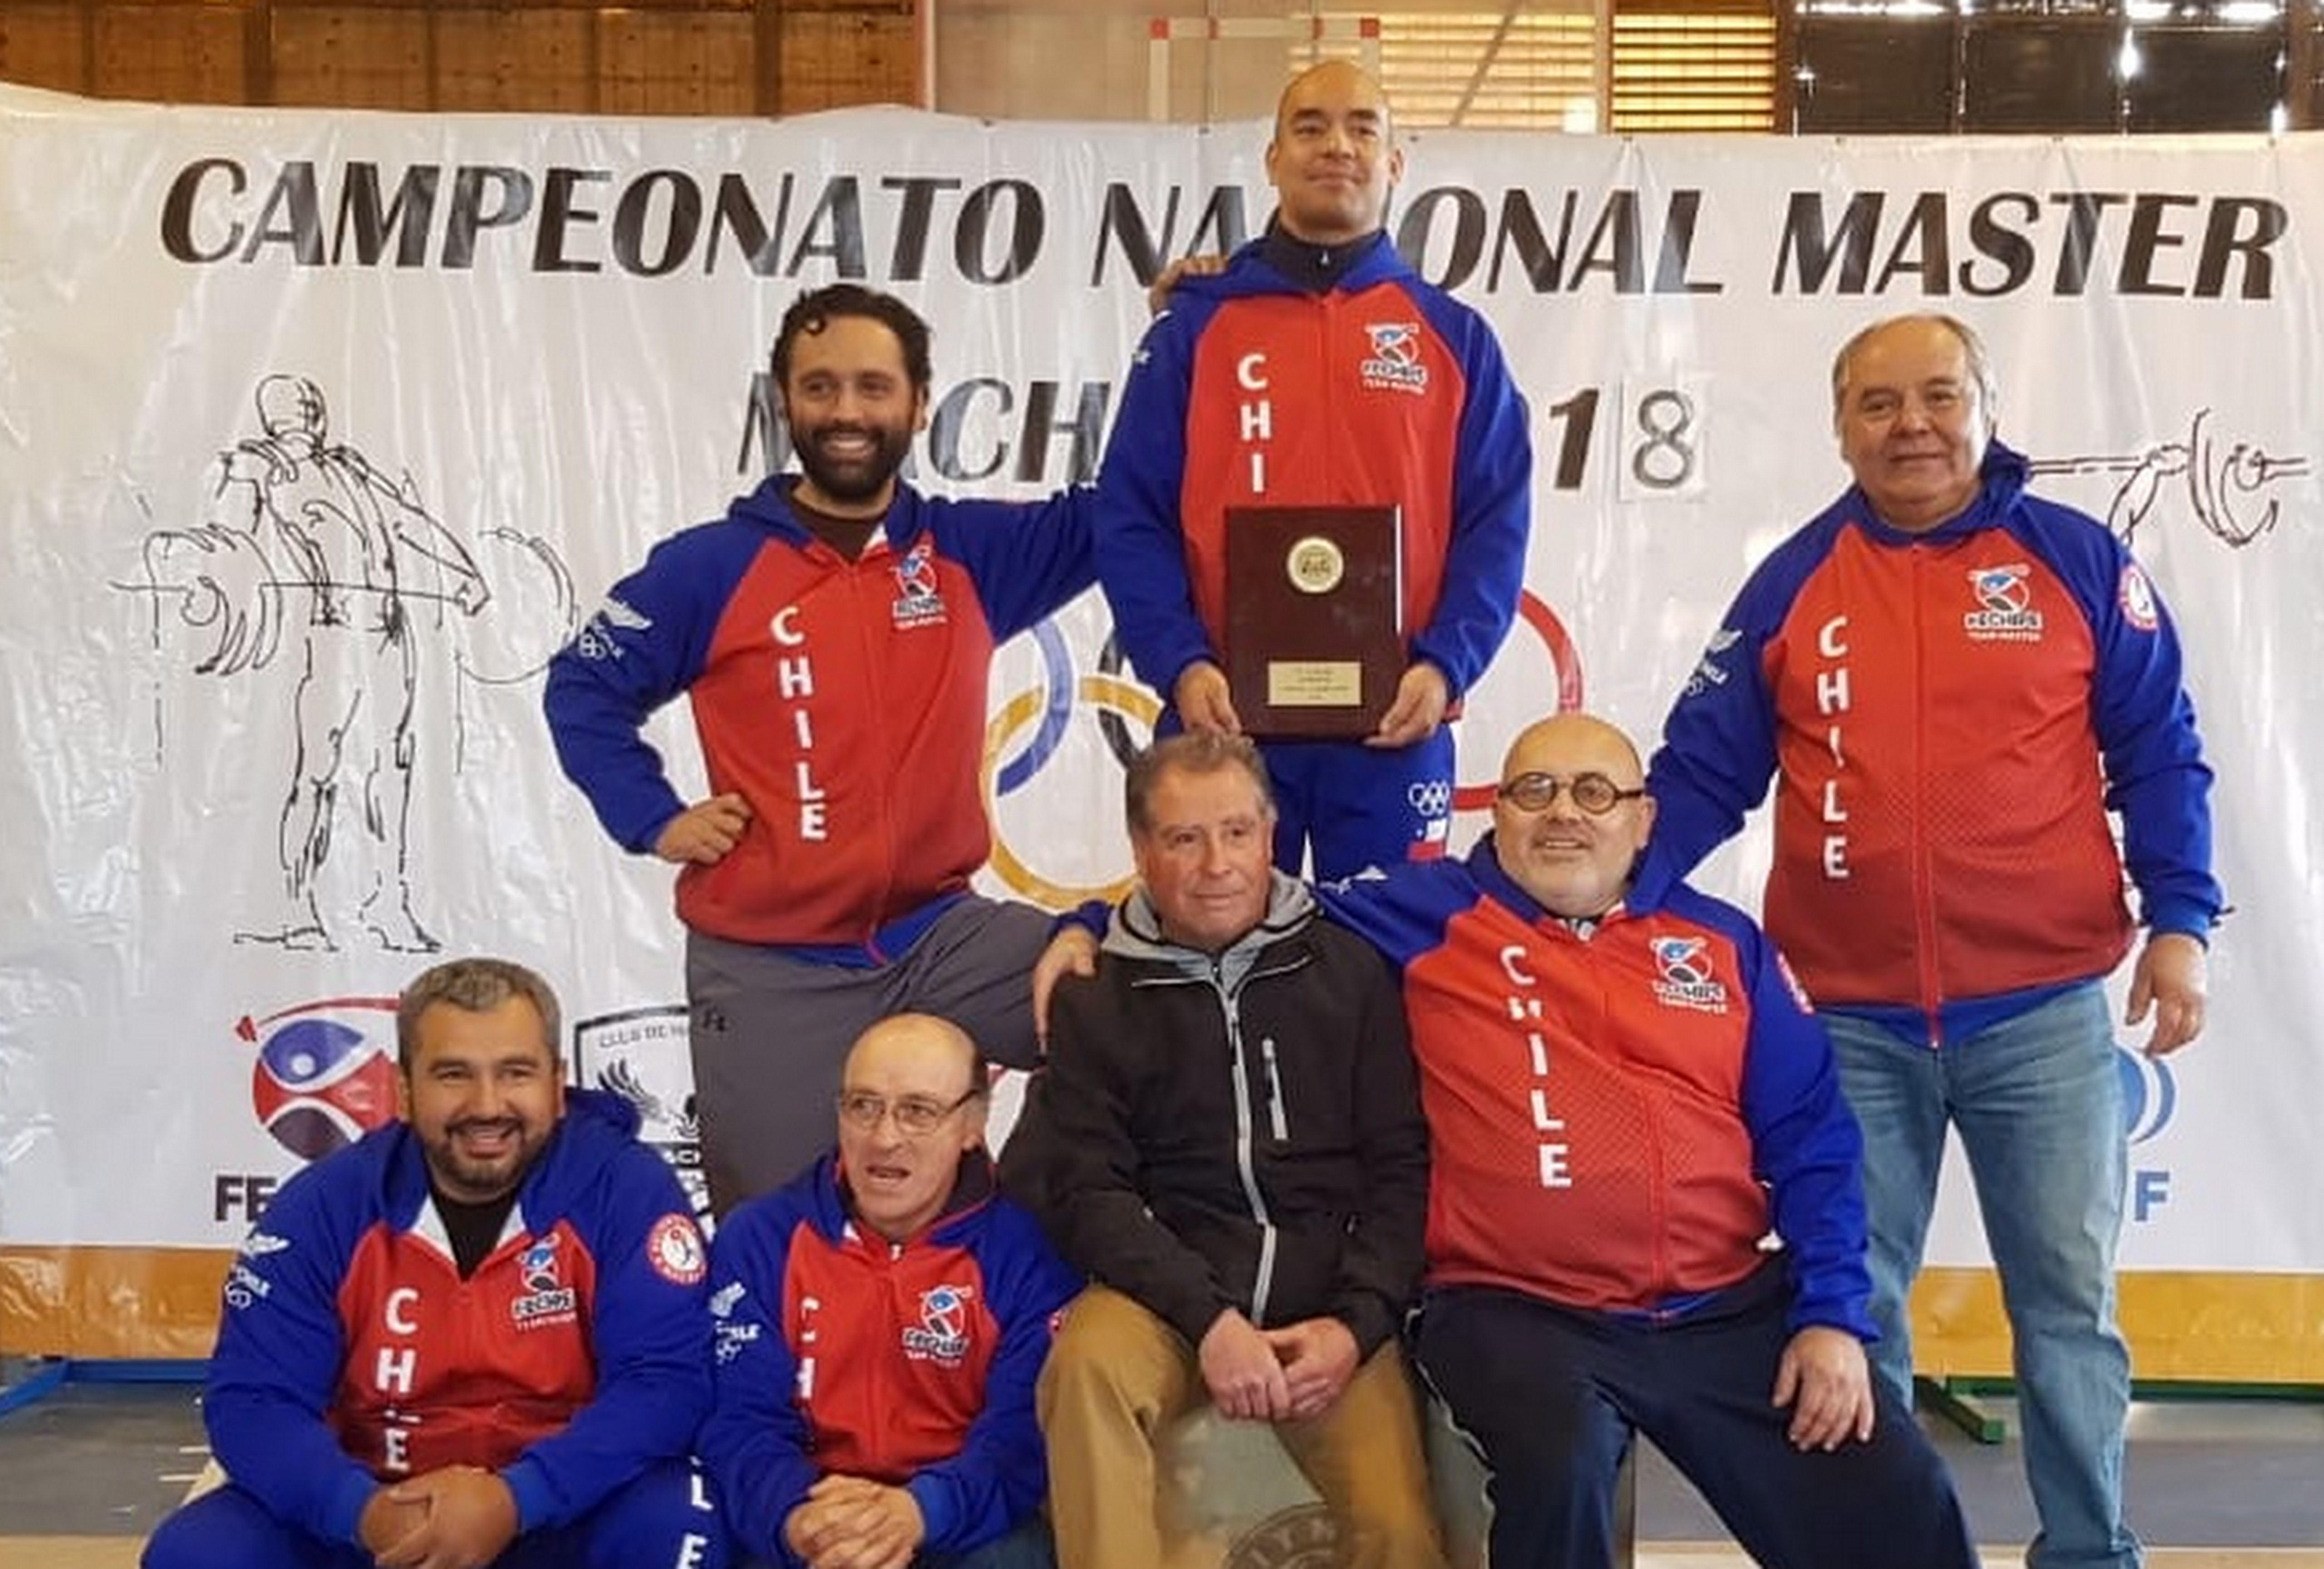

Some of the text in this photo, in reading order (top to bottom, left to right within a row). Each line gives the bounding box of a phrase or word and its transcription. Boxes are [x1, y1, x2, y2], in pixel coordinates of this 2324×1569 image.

[161, 157, 2289, 301] CAMPEONATO NAONAL MASTER
[770, 606, 828, 840] CHILE
[1817, 616, 1850, 878] CHILE
[376, 1288, 421, 1471] CHE
[676, 1456, 714, 1569] LE
